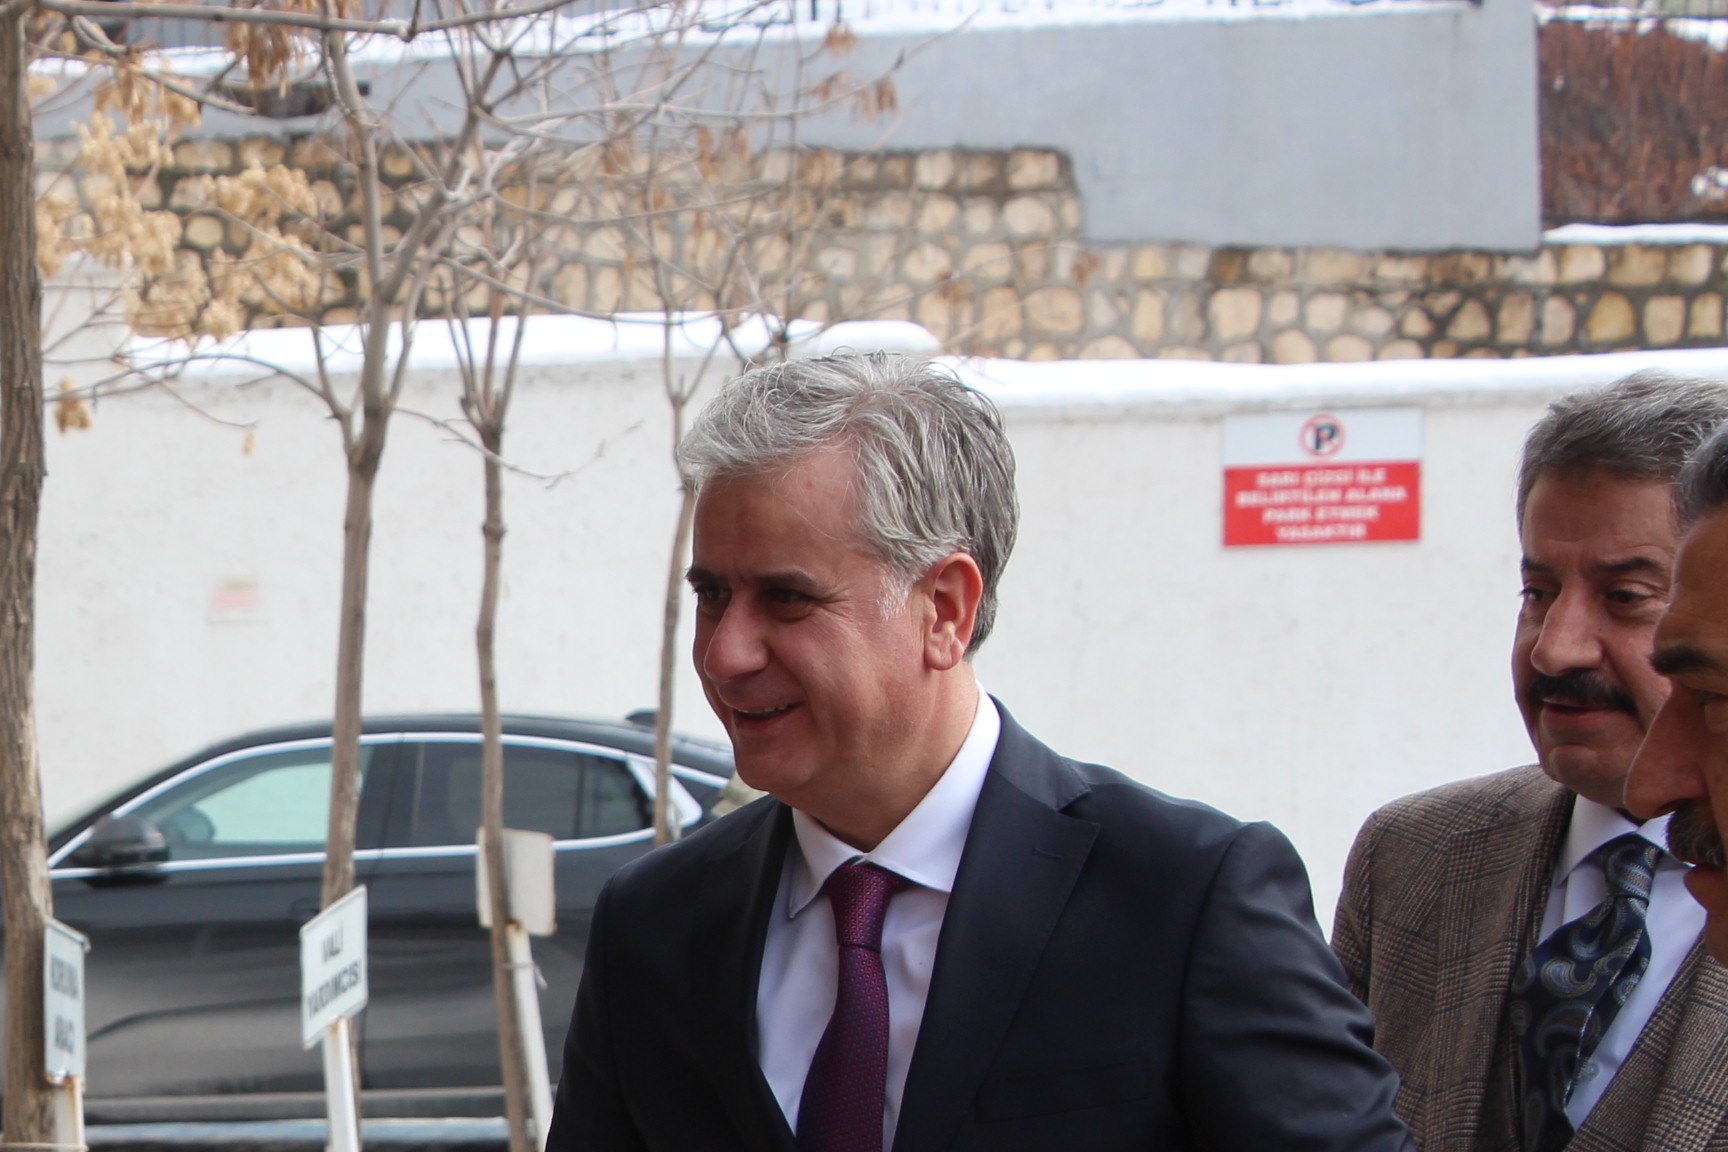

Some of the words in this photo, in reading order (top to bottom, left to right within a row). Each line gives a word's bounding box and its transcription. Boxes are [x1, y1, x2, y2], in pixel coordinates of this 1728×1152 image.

[1345, 485, 1407, 503] ALANA
[1262, 507, 1311, 523] PARK
[1315, 505, 1379, 521] ETMEK
[1276, 523, 1367, 541] YASAKTIR
